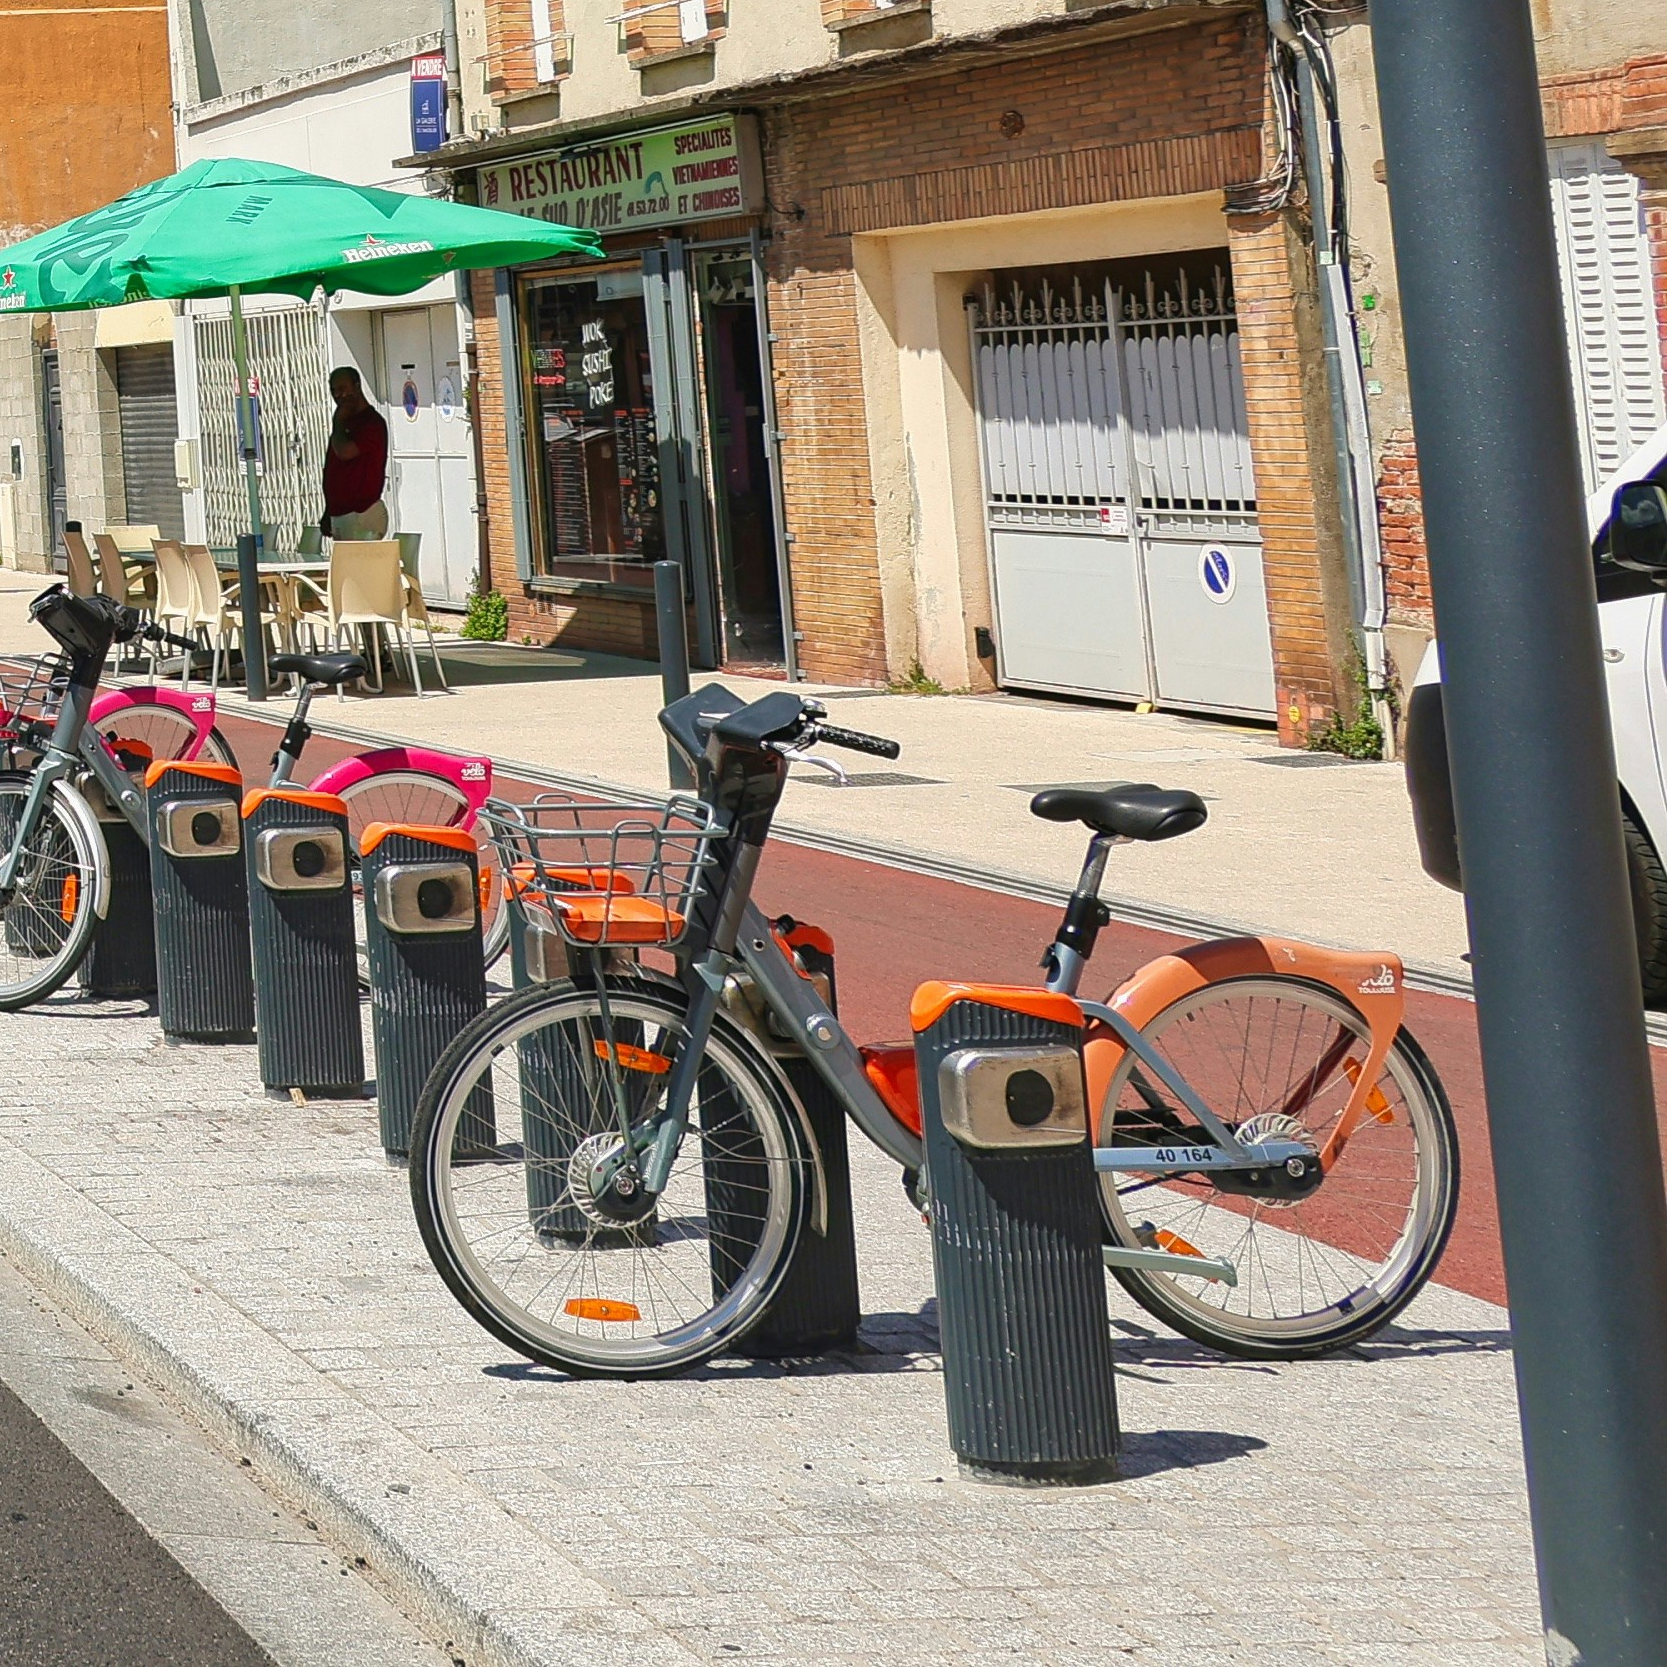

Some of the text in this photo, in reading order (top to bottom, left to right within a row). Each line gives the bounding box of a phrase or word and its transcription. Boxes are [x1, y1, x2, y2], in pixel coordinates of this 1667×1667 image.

[411, 58, 443, 76] A VENDRE
[509, 142, 644, 202] RESTAURANT
[672, 156, 739, 185] VIETNAMIENNES
[678, 186, 740, 215] ET CHINOISES
[341, 240, 434, 264] Heineken
[581, 319, 605, 344] WOK
[581, 347, 613, 376] SUSHI
[1155, 1147, 1213, 1162] 40 164
